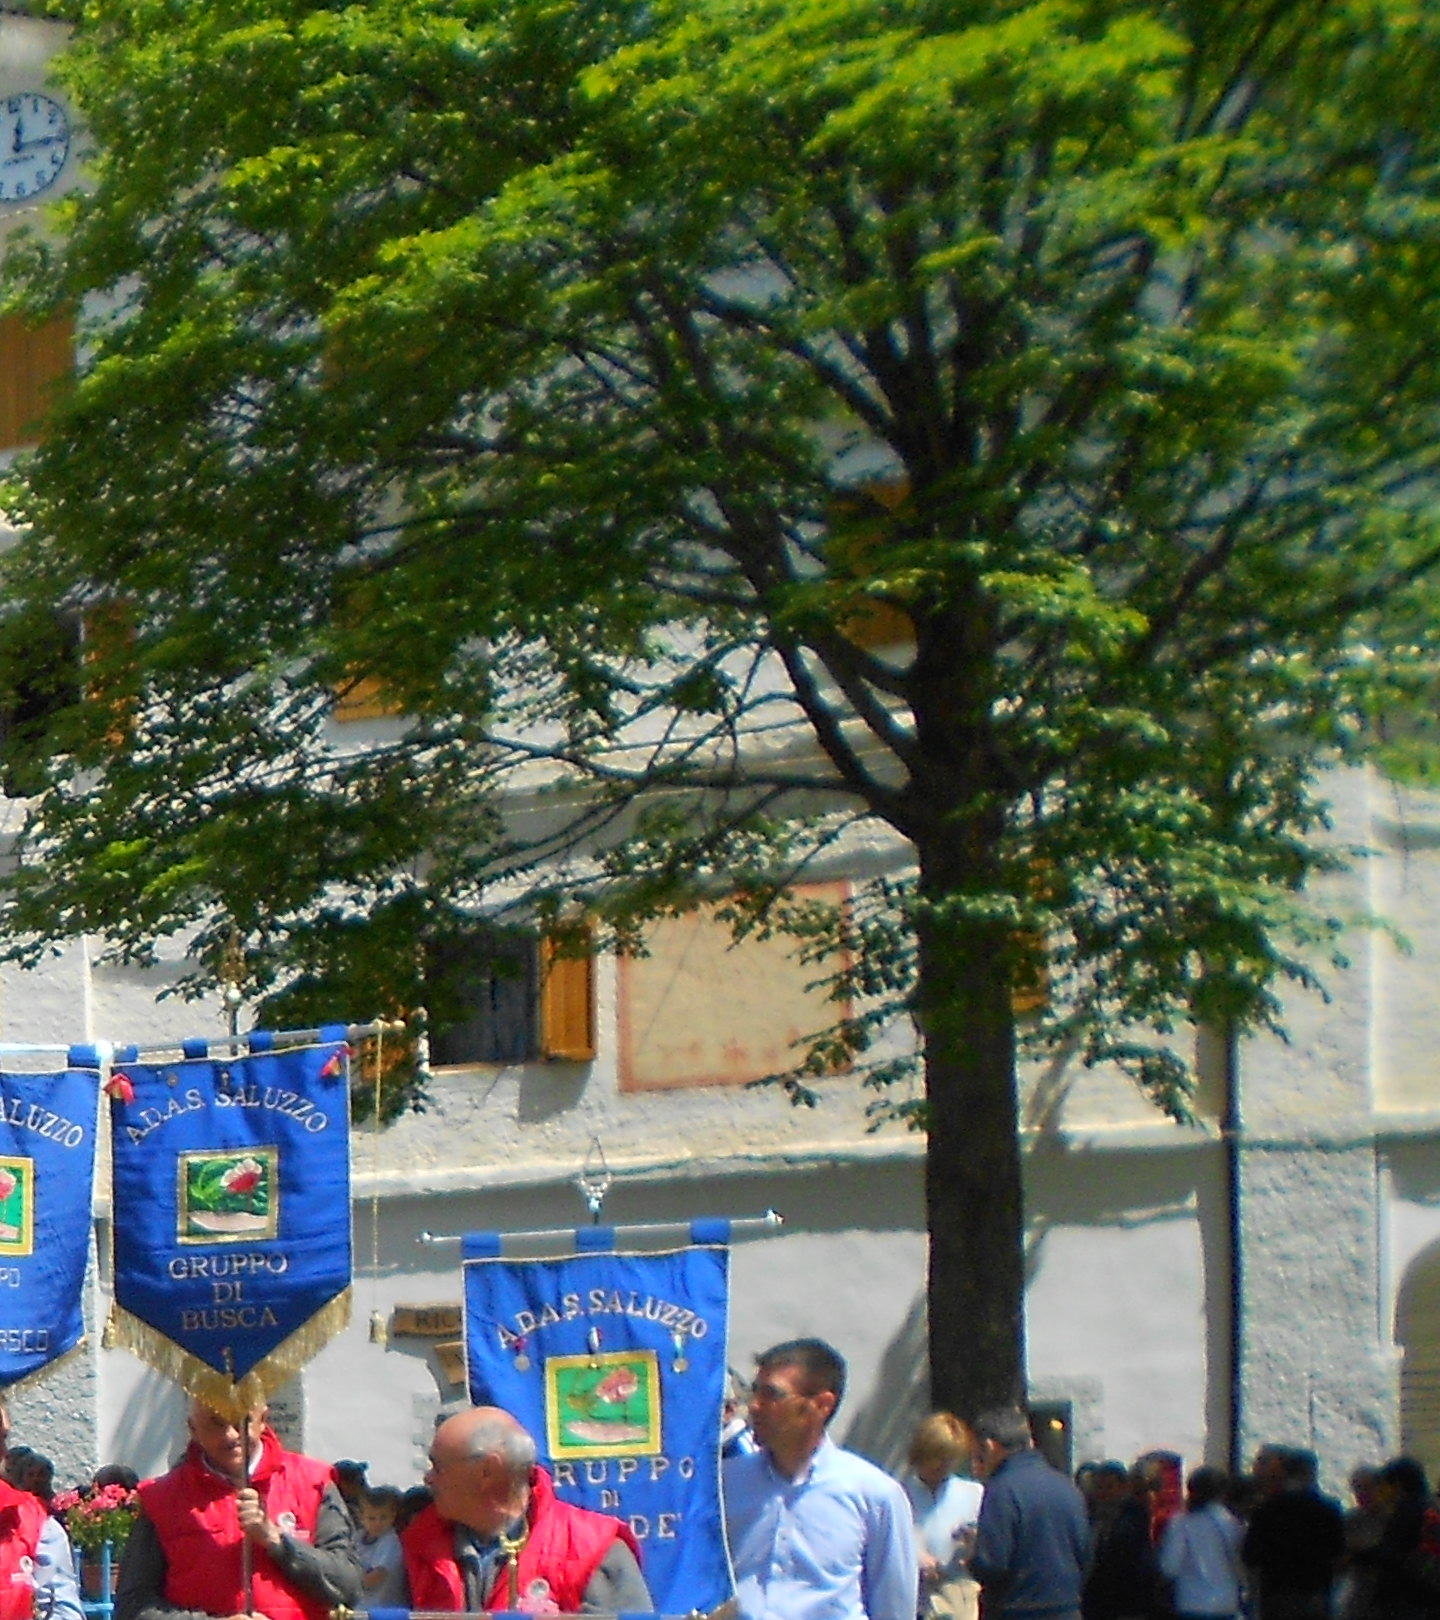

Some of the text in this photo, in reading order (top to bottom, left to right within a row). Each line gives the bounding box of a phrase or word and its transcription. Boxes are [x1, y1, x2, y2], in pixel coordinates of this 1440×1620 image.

[214, 1085, 329, 1135] SALUZZO
[168, 1253, 289, 1280] GRUPPO
[211, 1280, 245, 1304] DI
[181, 1306, 280, 1332] BUSCA
[587, 1288, 708, 1340] SALUZZO
[552, 1455, 695, 1488] RUPPO
[600, 1489, 620, 1509] DI
